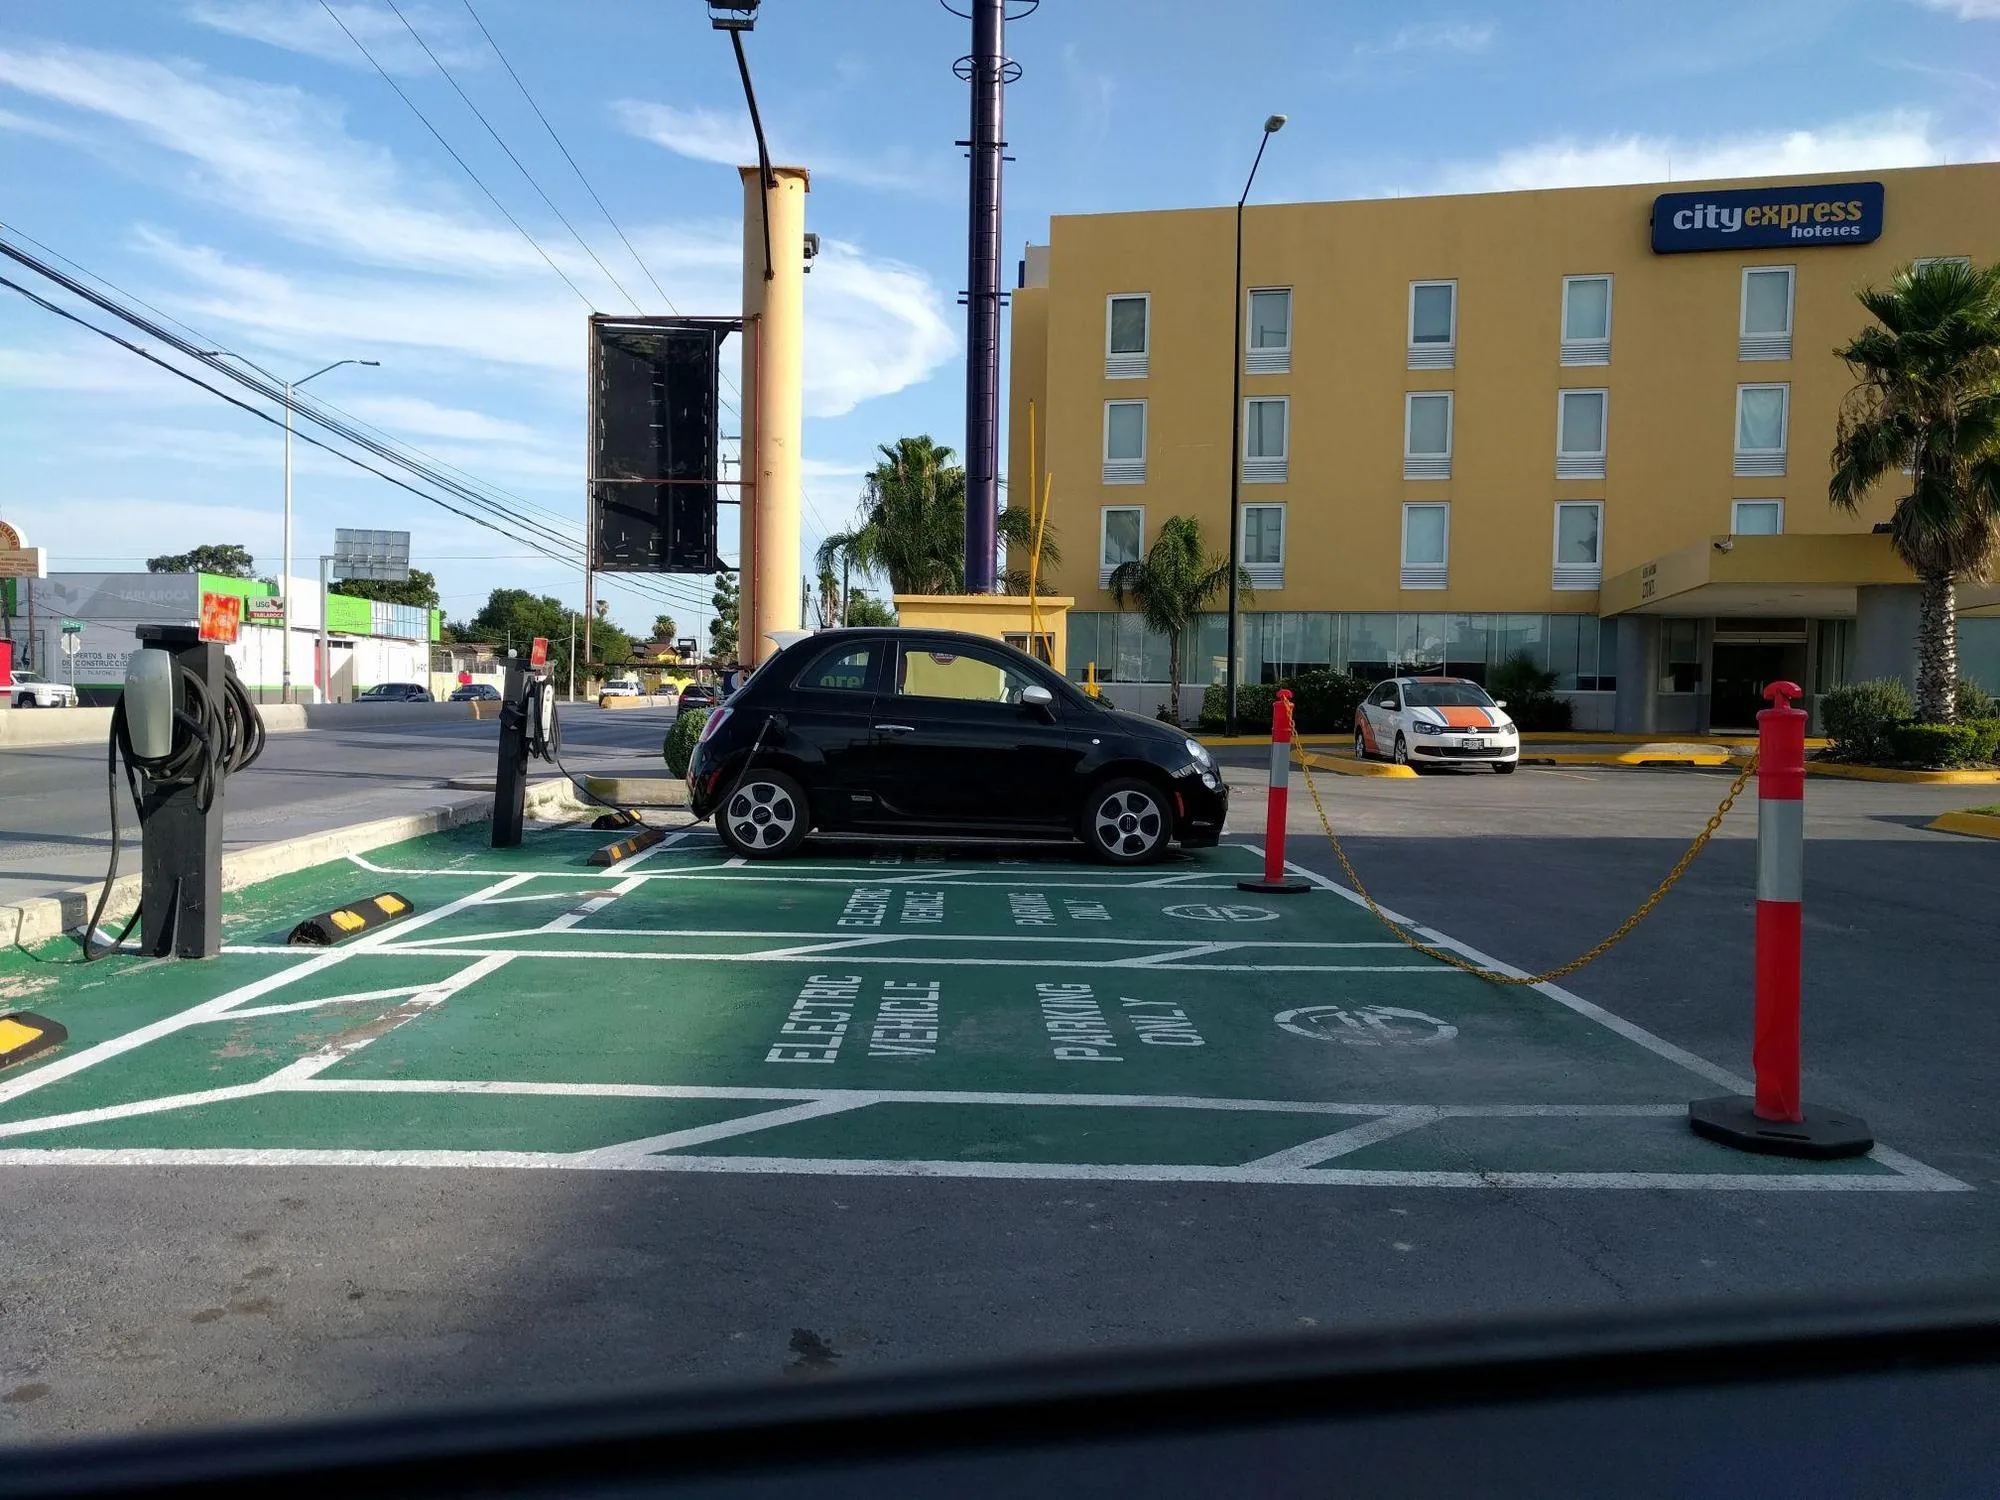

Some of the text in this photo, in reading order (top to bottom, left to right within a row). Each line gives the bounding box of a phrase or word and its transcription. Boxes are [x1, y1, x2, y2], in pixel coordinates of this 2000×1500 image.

[1673, 200, 1863, 232] cityexpress
[1791, 225, 1860, 238] hoteles
[255, 600, 270, 608] USG
[107, 652, 117, 660] EN
[120, 652, 133, 660] SIS
[836, 888, 892, 927] ELECTRIC
[900, 891, 944, 924] VEHICLE
[1007, 892, 1058, 926] PARKING
[1063, 898, 1113, 921] ONLY
[765, 974, 862, 1063] ELECTRIC
[868, 980, 940, 1056] VEHICLE
[1035, 983, 1124, 1061] PARKING
[1119, 996, 1206, 1046] ONLY
